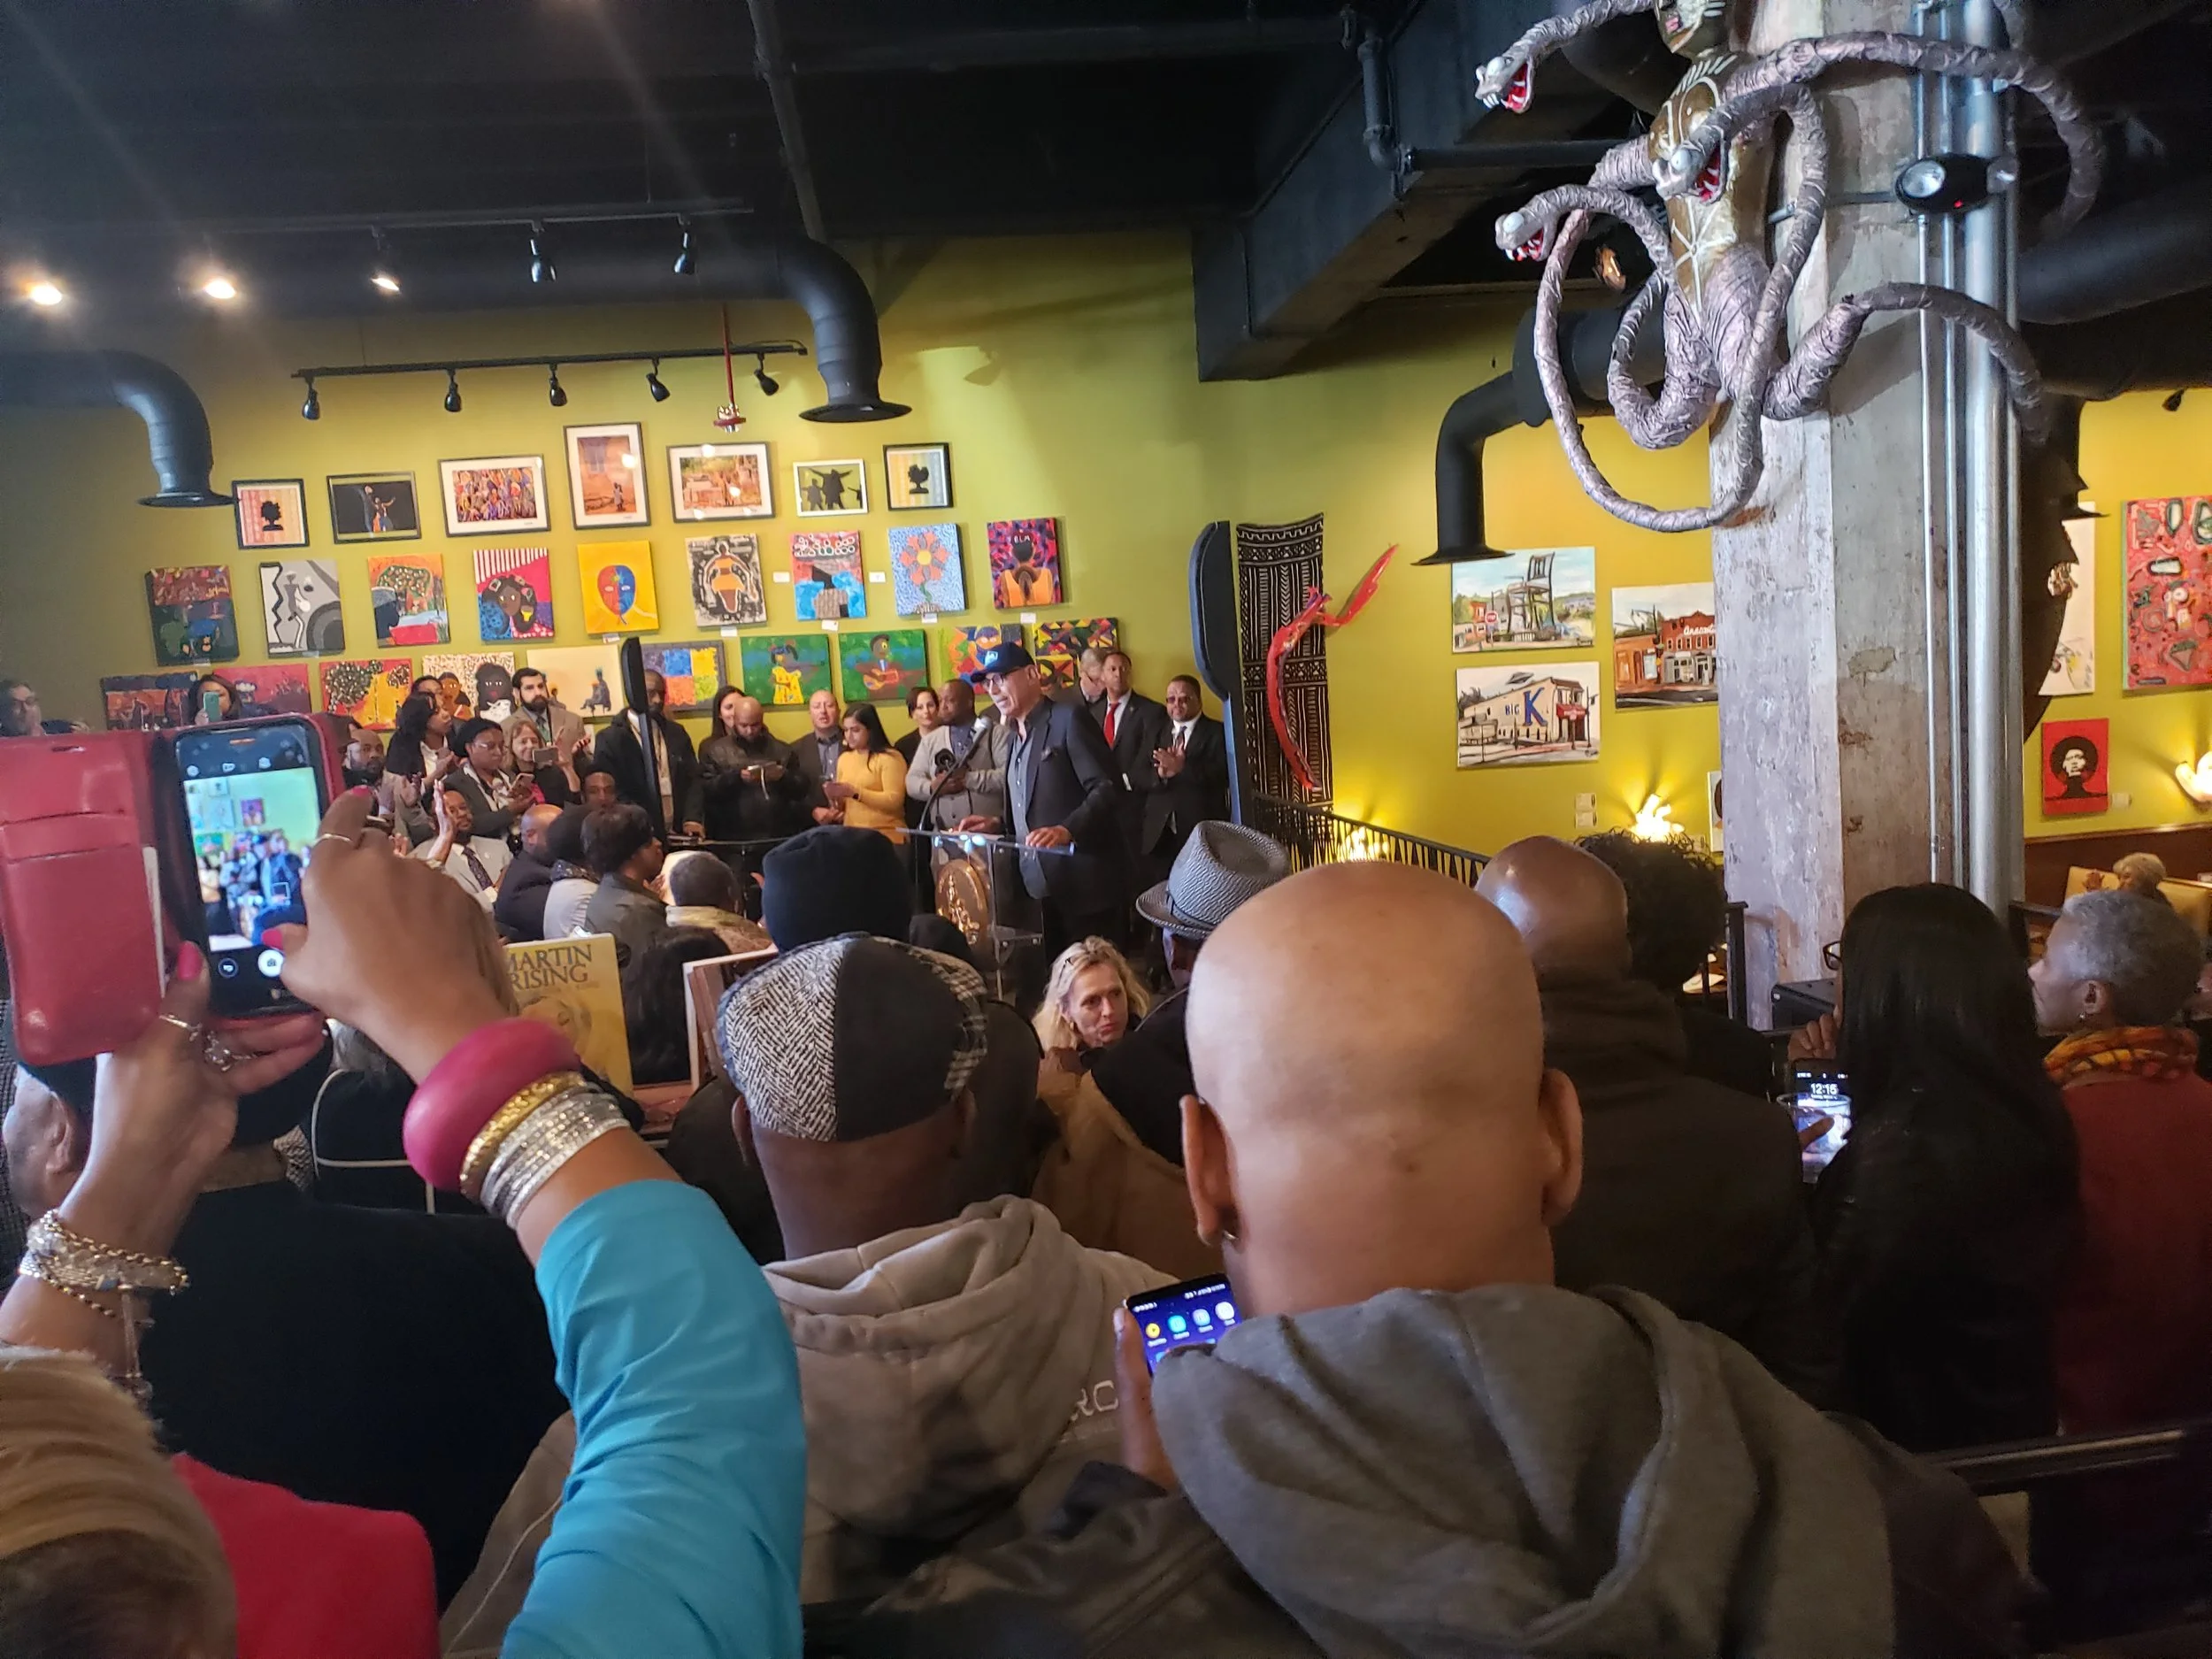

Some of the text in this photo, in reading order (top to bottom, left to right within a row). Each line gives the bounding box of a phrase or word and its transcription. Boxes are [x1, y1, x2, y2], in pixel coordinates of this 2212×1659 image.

[1014, 534, 1031, 543] BLM
[1505, 687, 1548, 726] BIG K
[507, 964, 588, 990] RISING
